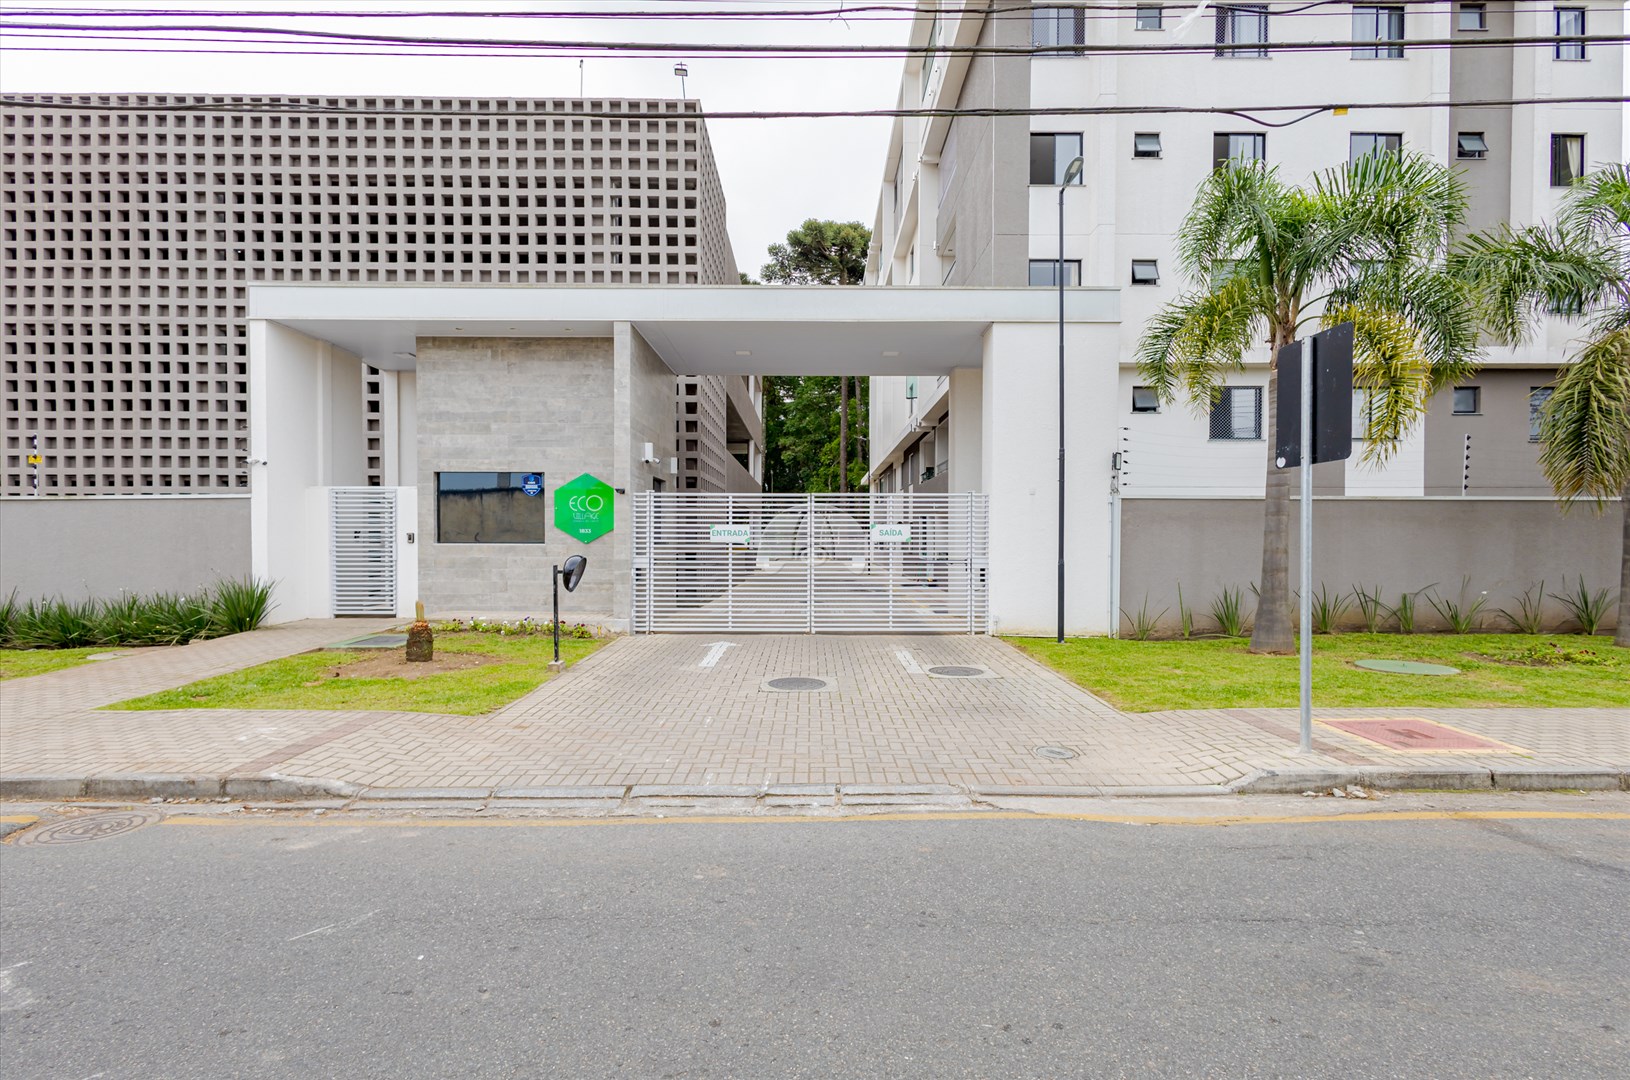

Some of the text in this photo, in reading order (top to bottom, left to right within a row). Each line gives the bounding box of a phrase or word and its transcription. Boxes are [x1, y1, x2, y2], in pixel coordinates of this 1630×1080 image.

[569, 495, 603, 512] ECO
[711, 529, 749, 537] ENTRADA
[879, 528, 903, 537] SAÍDA
